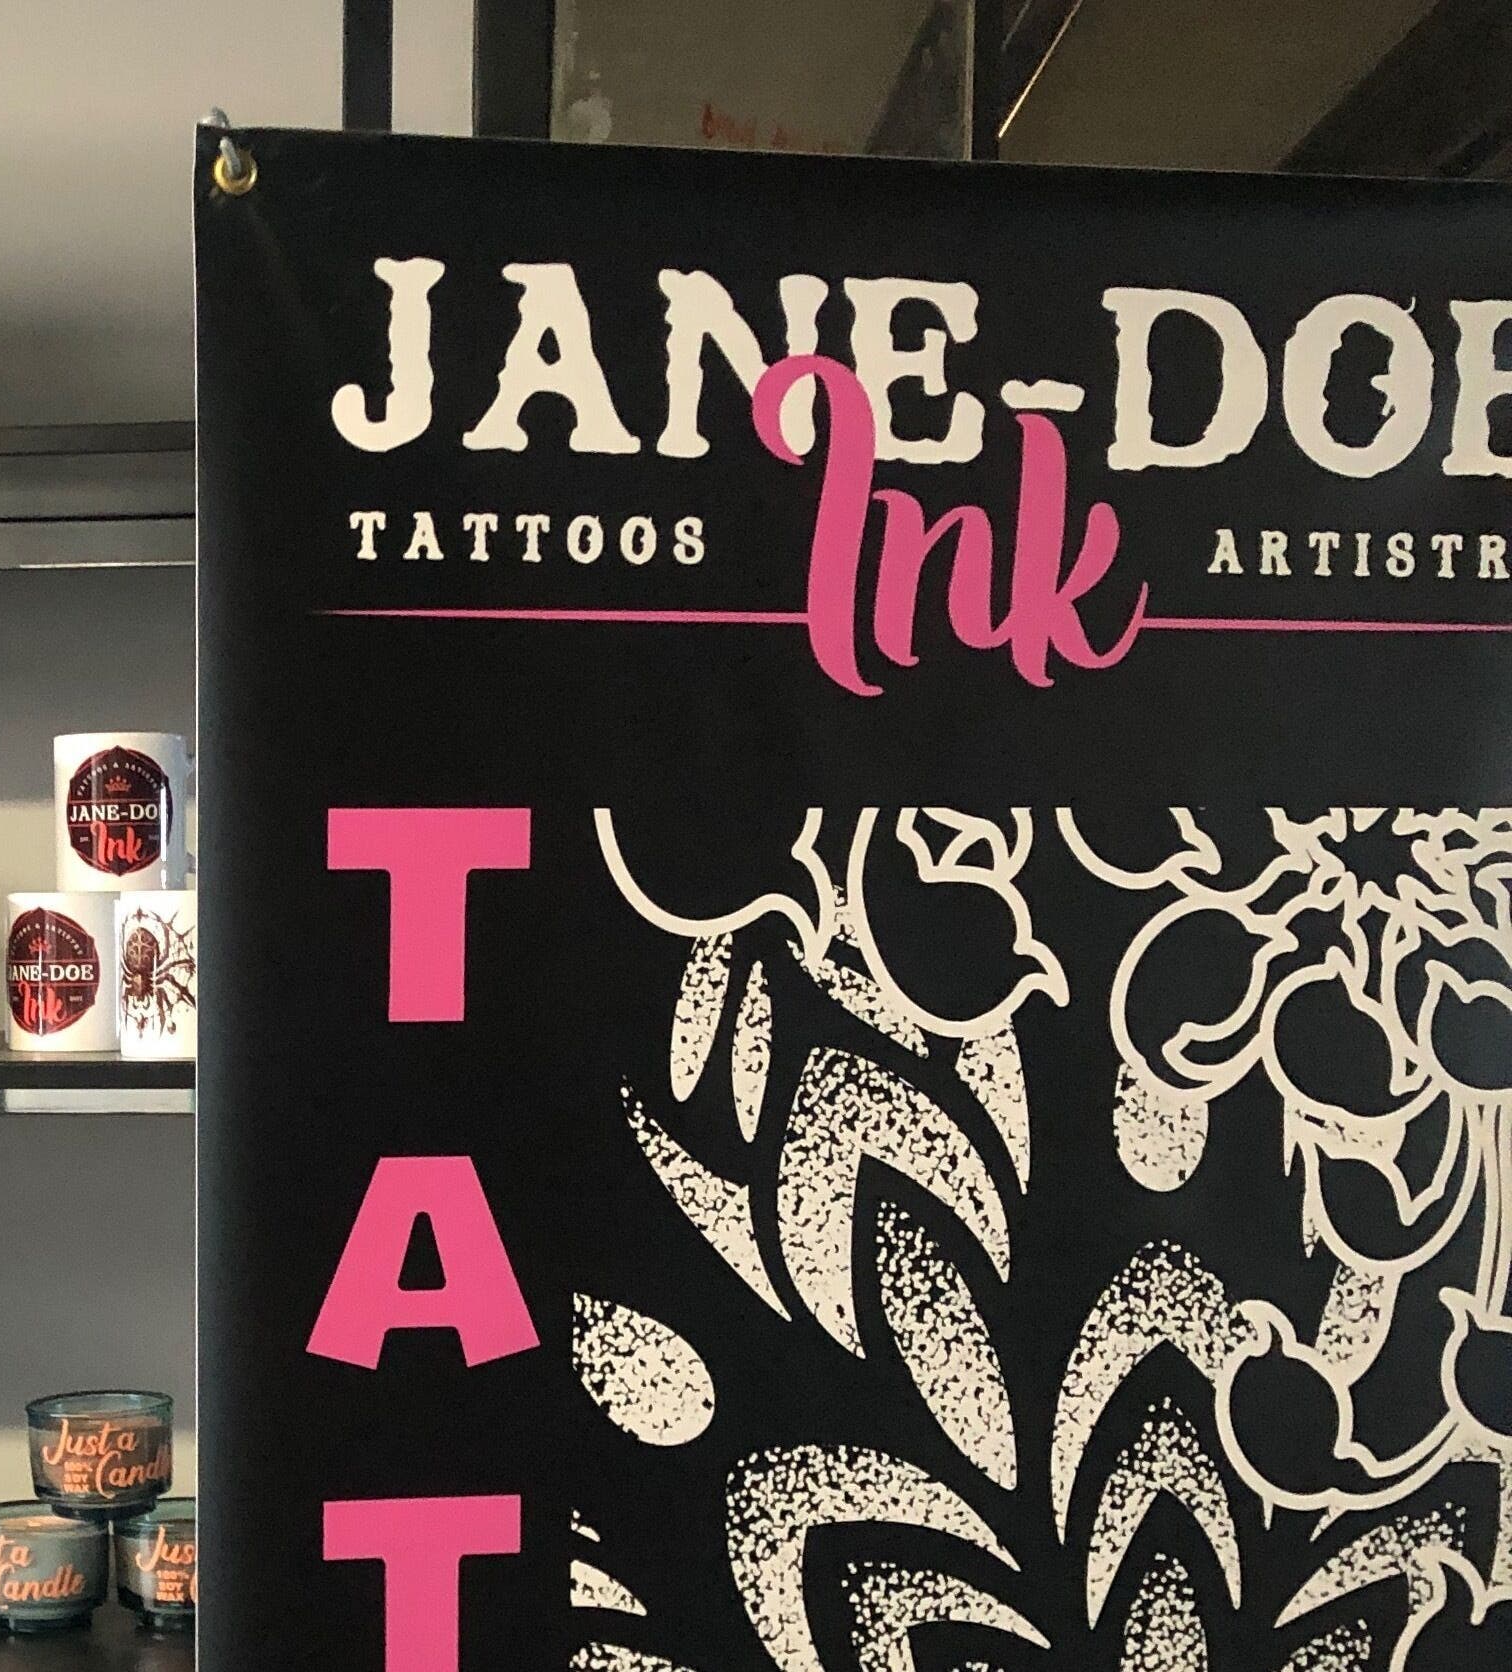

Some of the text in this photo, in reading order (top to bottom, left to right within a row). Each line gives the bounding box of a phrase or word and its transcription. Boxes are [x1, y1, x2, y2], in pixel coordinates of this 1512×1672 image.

[349, 511, 705, 565] TATTOOS
[752, 355, 1149, 696] Ink
[70, 803, 163, 823] JANE-DO
[90, 820, 148, 866] Ink
[19, 981, 68, 1026] Ink
[43, 1418, 138, 1465] Just a
[95, 1450, 171, 1499] Candl
[10, 1545, 31, 1567] a
[135, 1524, 195, 1572] Jus
